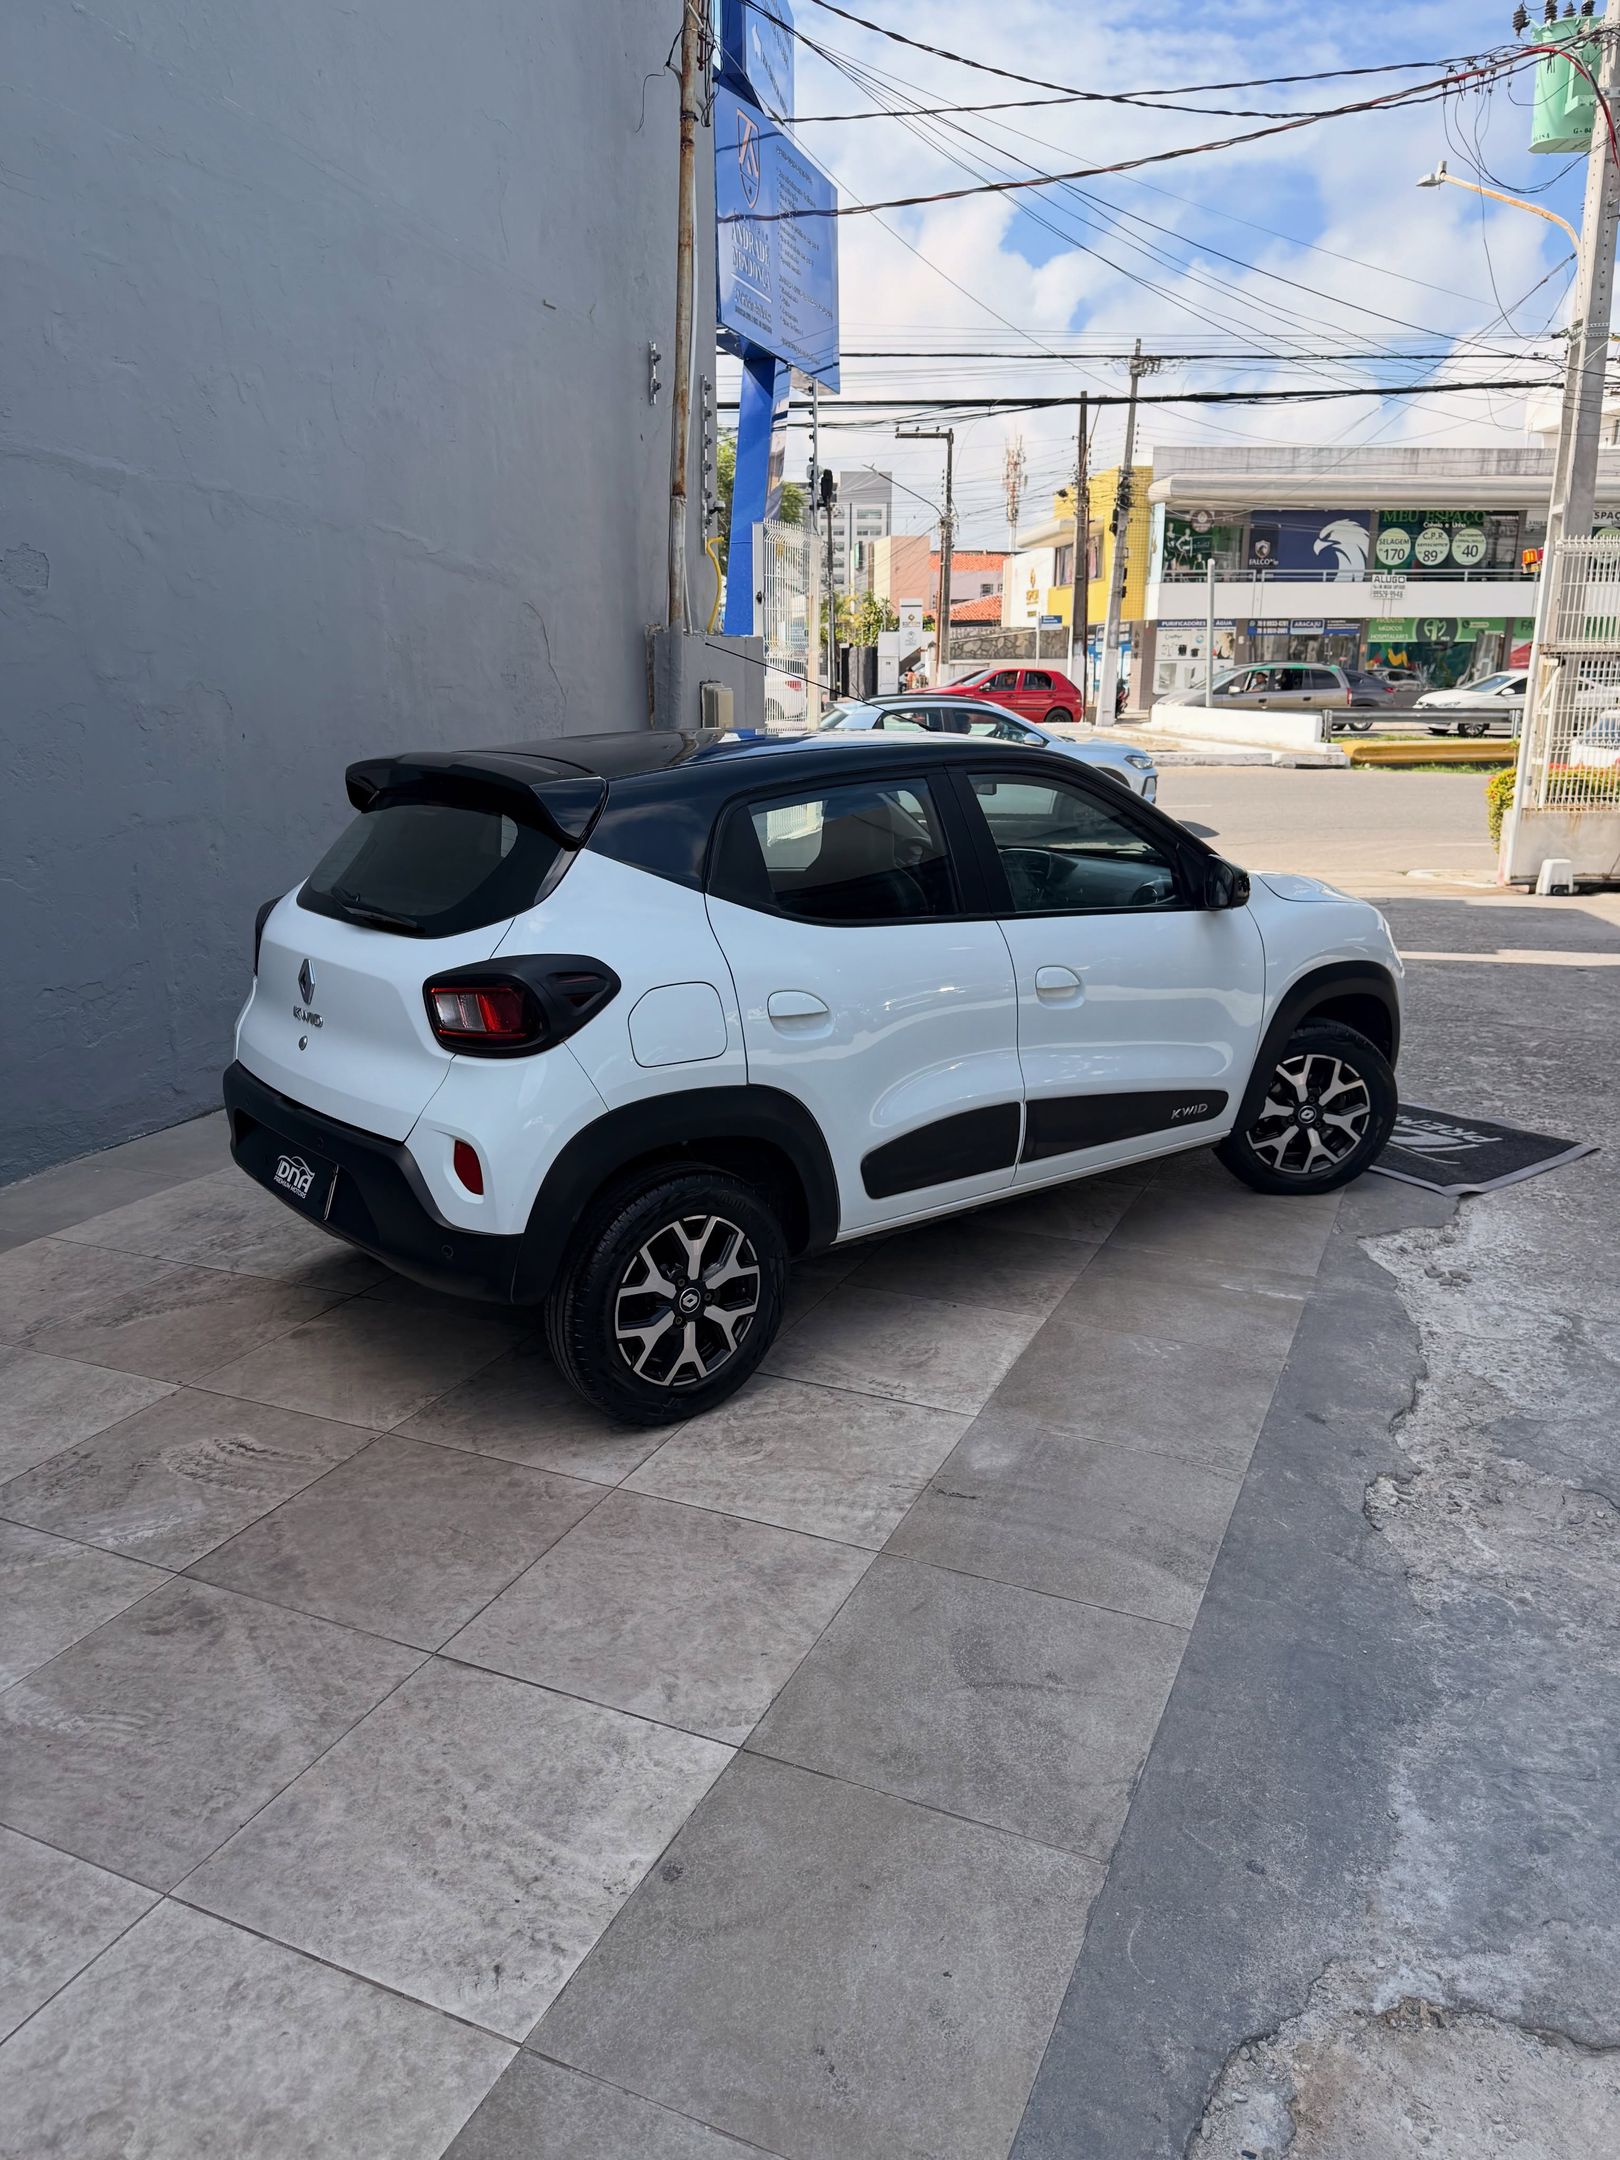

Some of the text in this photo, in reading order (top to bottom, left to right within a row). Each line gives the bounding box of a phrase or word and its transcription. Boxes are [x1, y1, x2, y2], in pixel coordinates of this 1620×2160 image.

[731, 220, 770, 265] ANDRADE
[1383, 510, 1418, 522] MEU
[1426, 510, 1486, 525] ESPAÇO
[1383, 548, 1405, 560] 170
[1423, 550, 1438, 562] 89
[1462, 545, 1479, 557] 40
[293, 1005, 324, 1028] KWID
[1170, 1103, 1208, 1119] KWID
